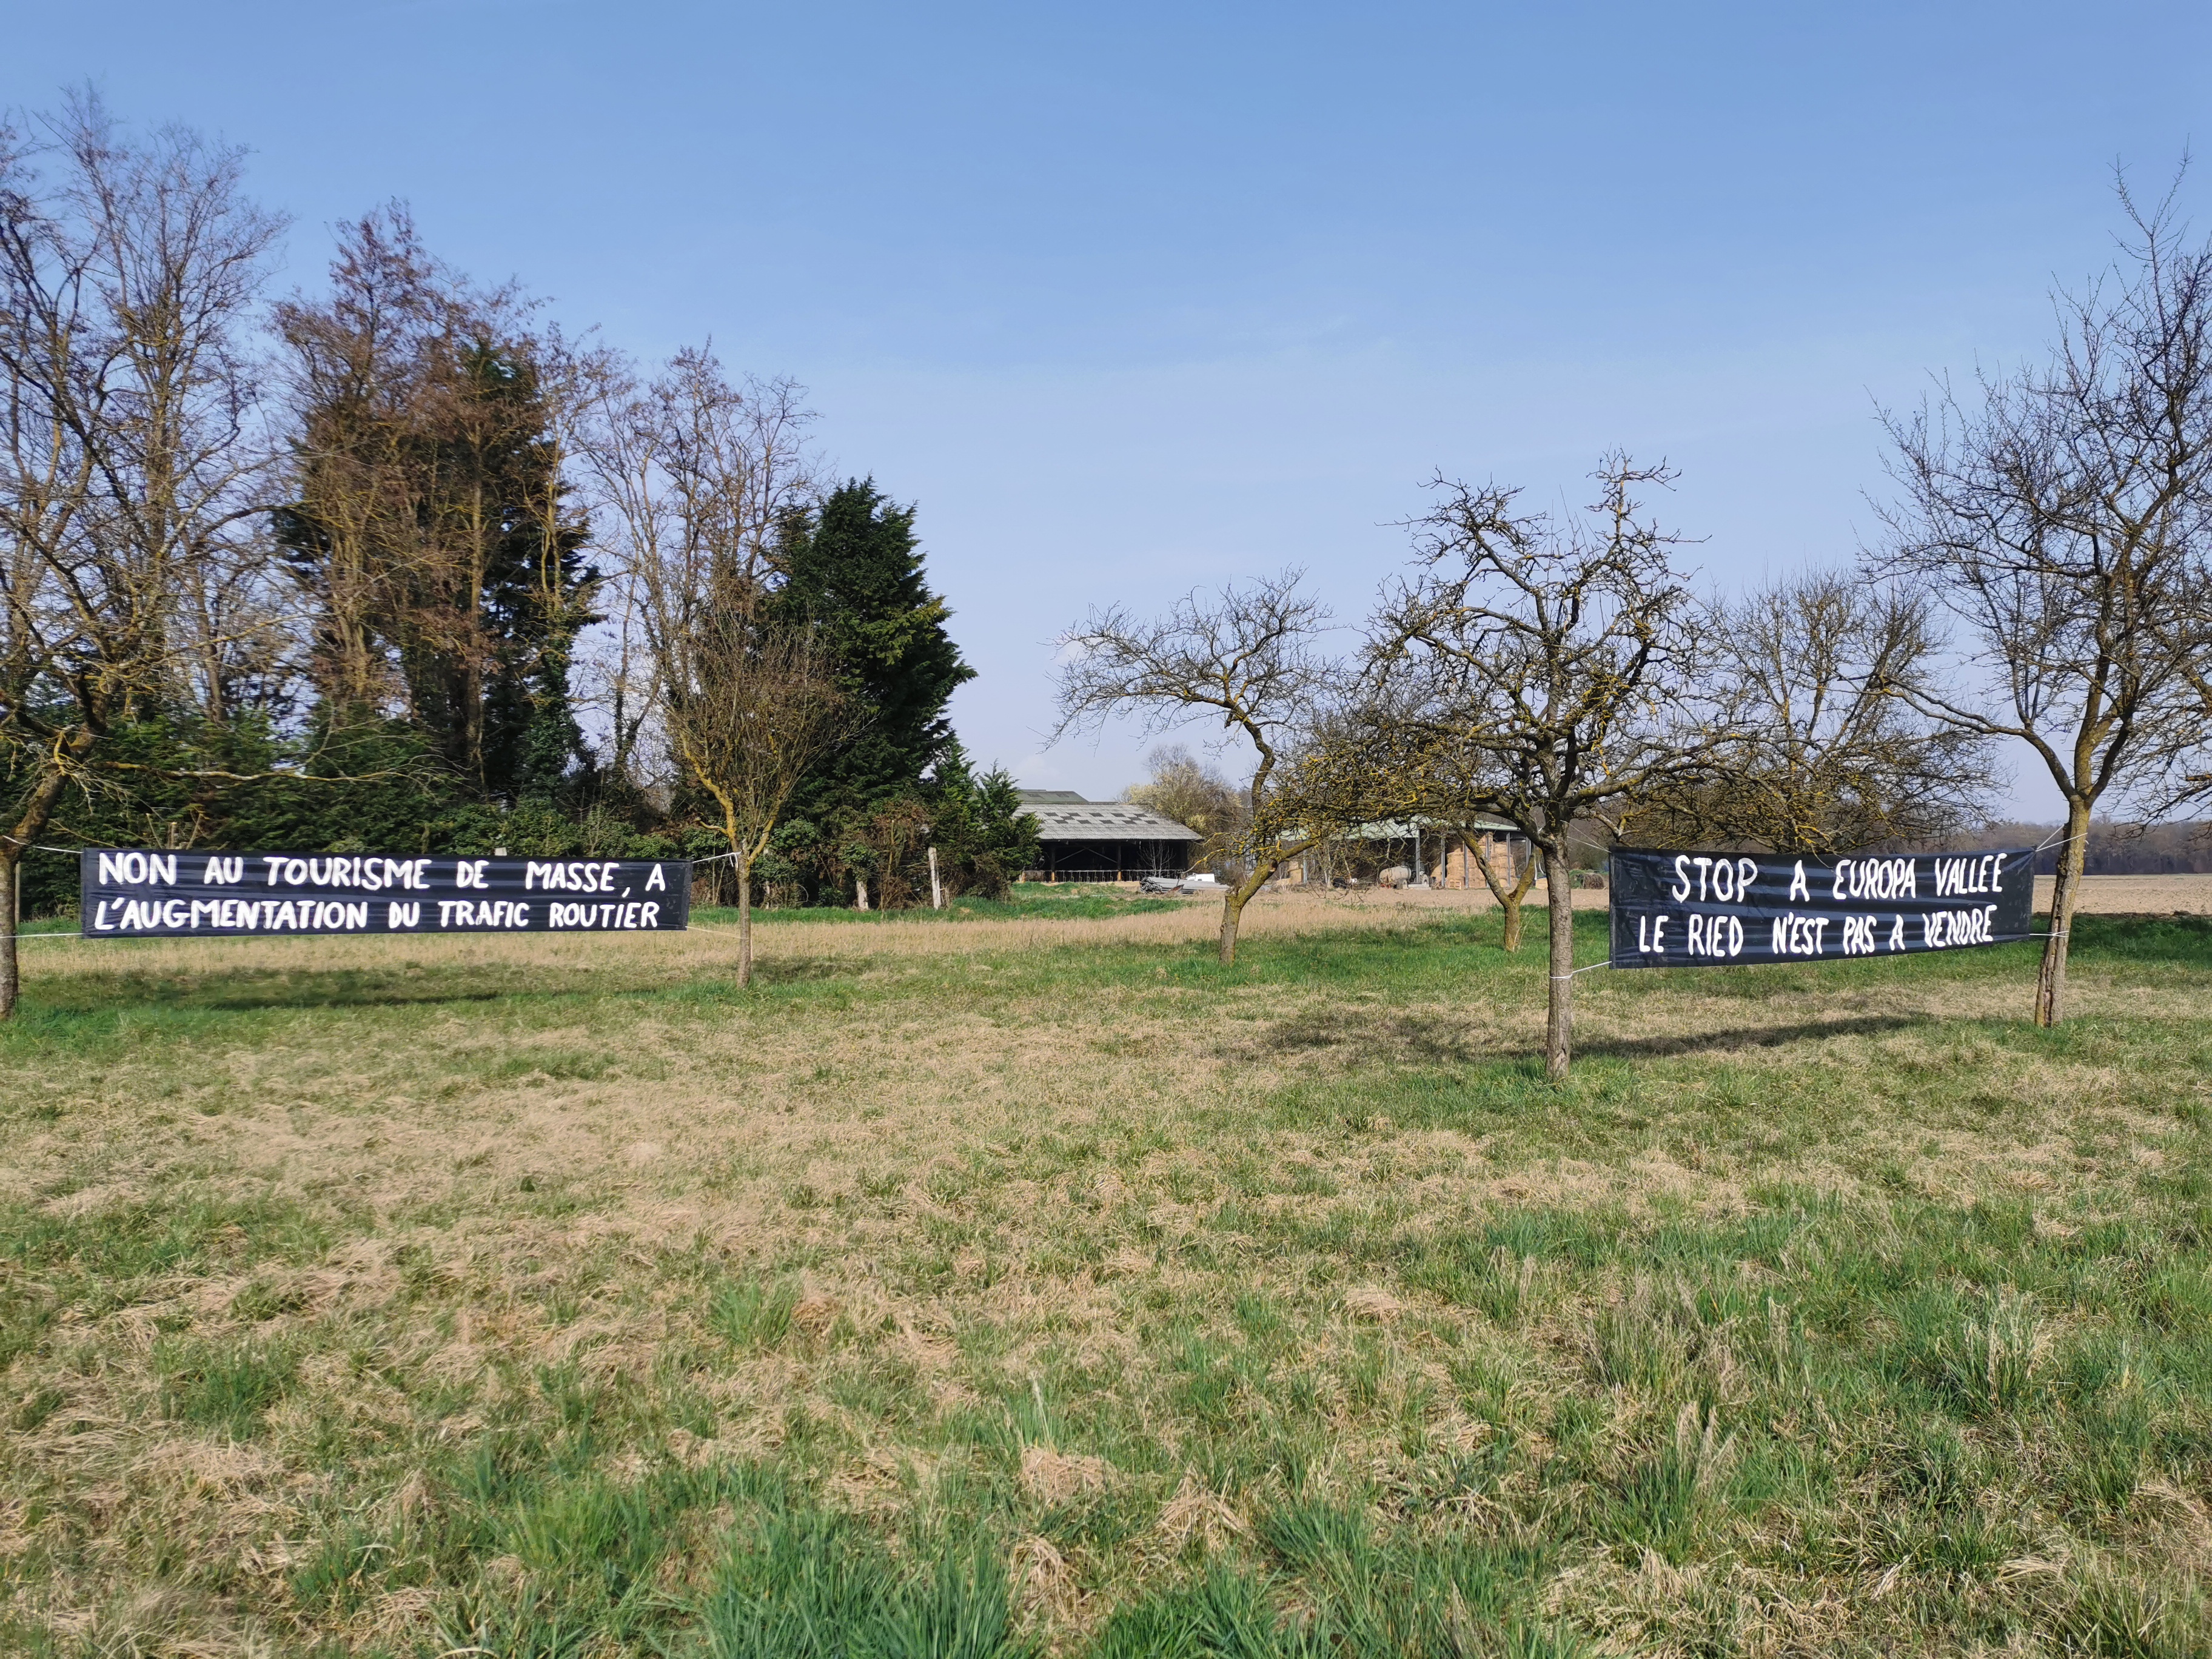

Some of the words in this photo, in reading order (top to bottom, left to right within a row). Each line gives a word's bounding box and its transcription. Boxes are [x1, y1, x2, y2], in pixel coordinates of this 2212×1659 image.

[99, 852, 177, 886] NON
[204, 856, 244, 885] AU
[263, 856, 432, 891] TOURISME
[455, 860, 490, 889] DE
[525, 861, 631, 898] MASSE,
[645, 863, 666, 891] A
[1672, 854, 1758, 903] STOP
[1789, 859, 1810, 902] A
[1832, 857, 1916, 900] EUROPA
[1934, 853, 2008, 897] VALLEE
[93, 897, 368, 930] L'AUGMENTATION
[388, 901, 420, 929] DU
[437, 900, 530, 928] TRAFIC
[549, 901, 660, 928] ROUTIER
[1639, 915, 1669, 953] LE
[1687, 914, 1744, 957] RIED
[1772, 911, 1829, 955] N'EST
[1842, 915, 1877, 955] PAS
[1888, 914, 1906, 951] A
[1922, 904, 1997, 948] VENDRE
